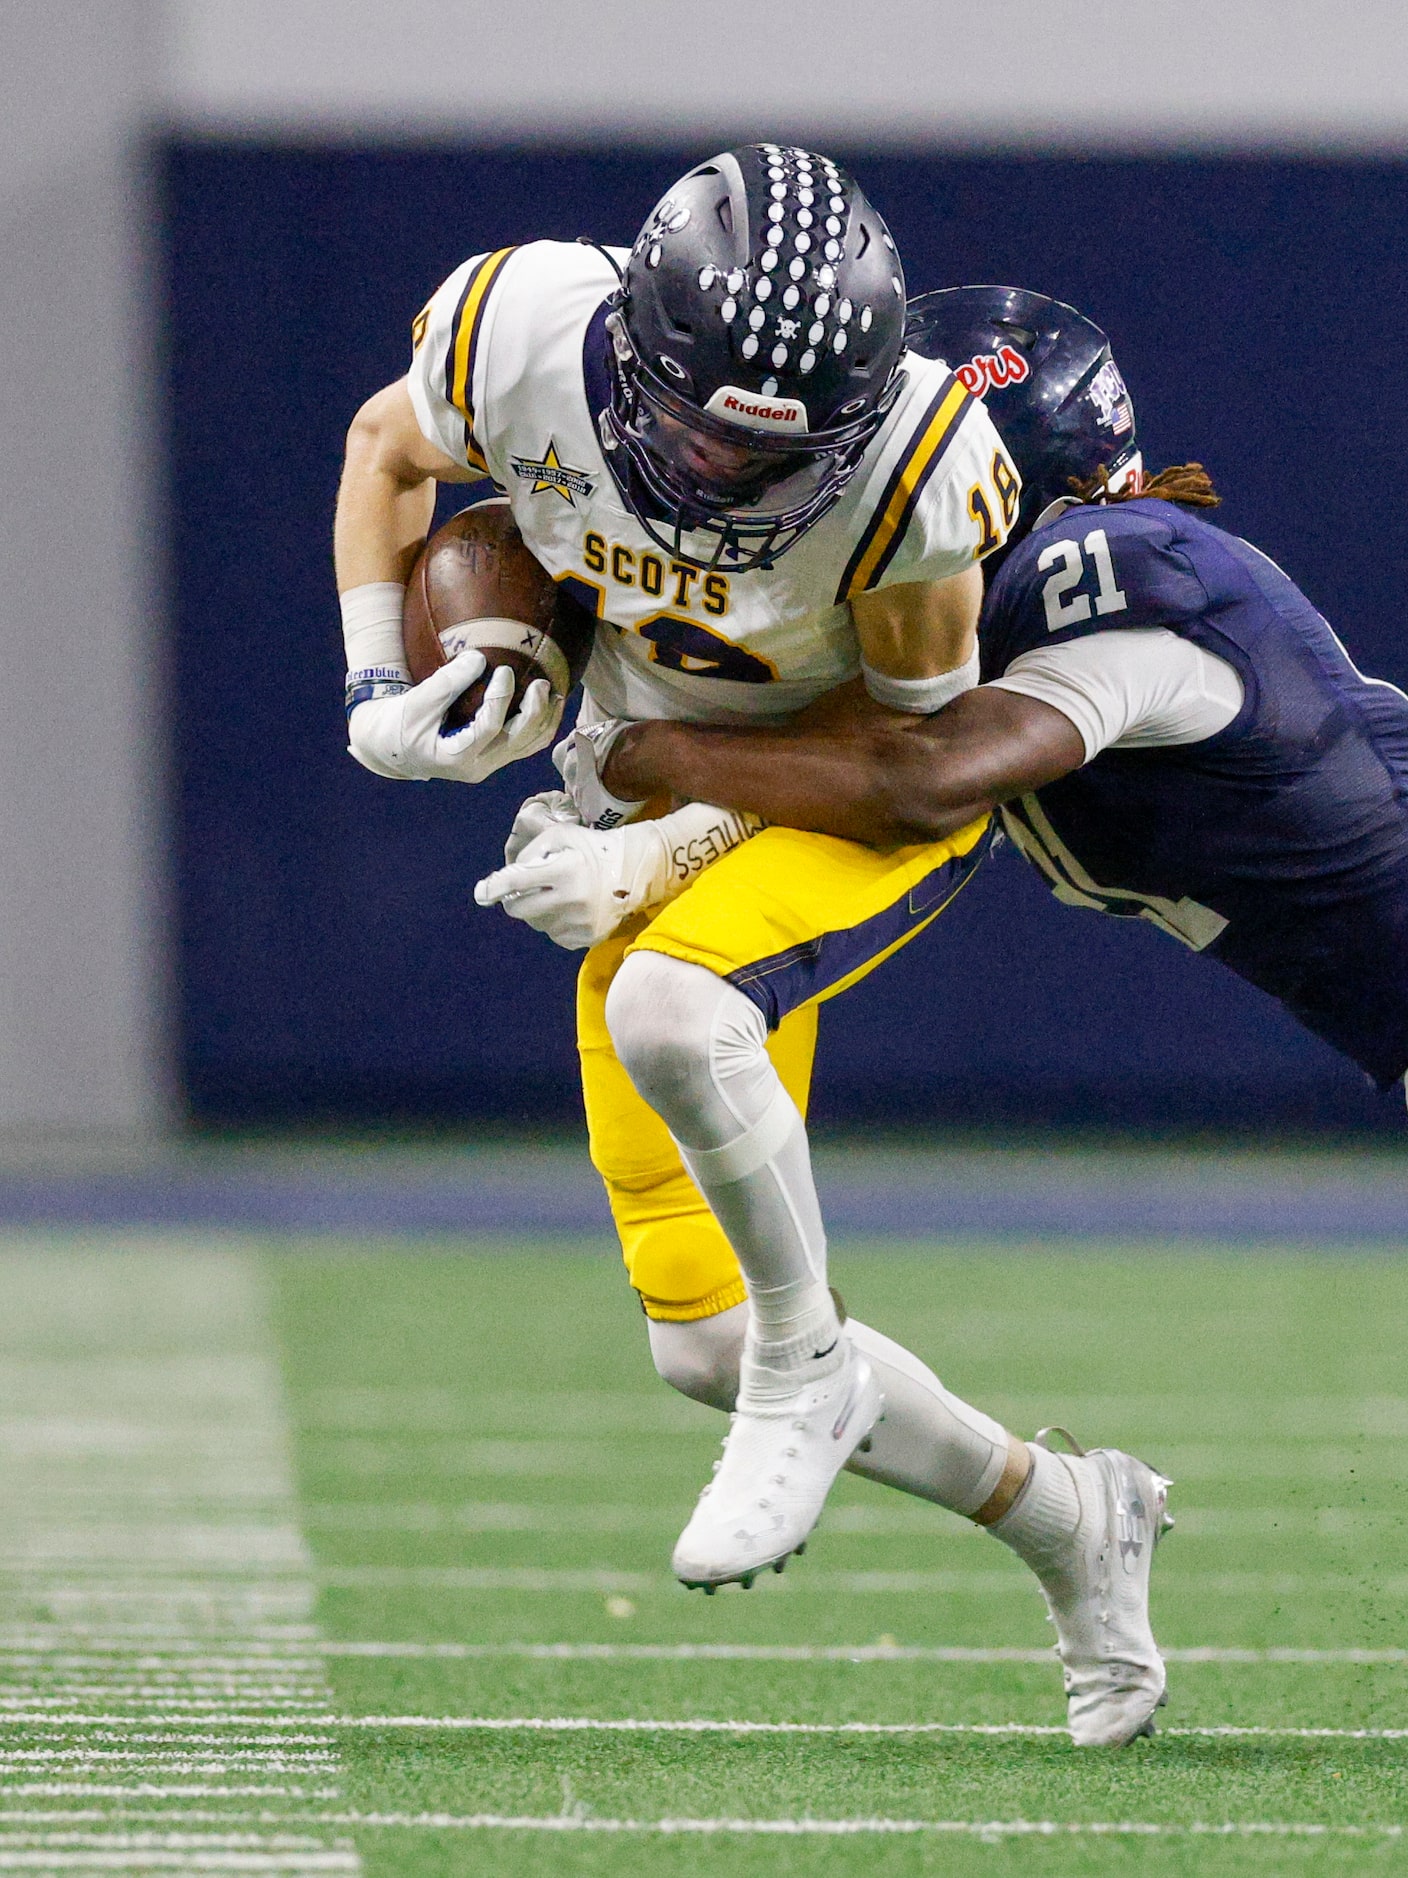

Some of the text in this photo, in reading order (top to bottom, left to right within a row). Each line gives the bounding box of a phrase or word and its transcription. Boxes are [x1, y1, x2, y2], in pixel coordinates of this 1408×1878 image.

[724, 395, 797, 421] Riddell
[967, 447, 1022, 560] 18
[584, 529, 730, 617] SCOTS
[1037, 529, 1128, 633] 21
